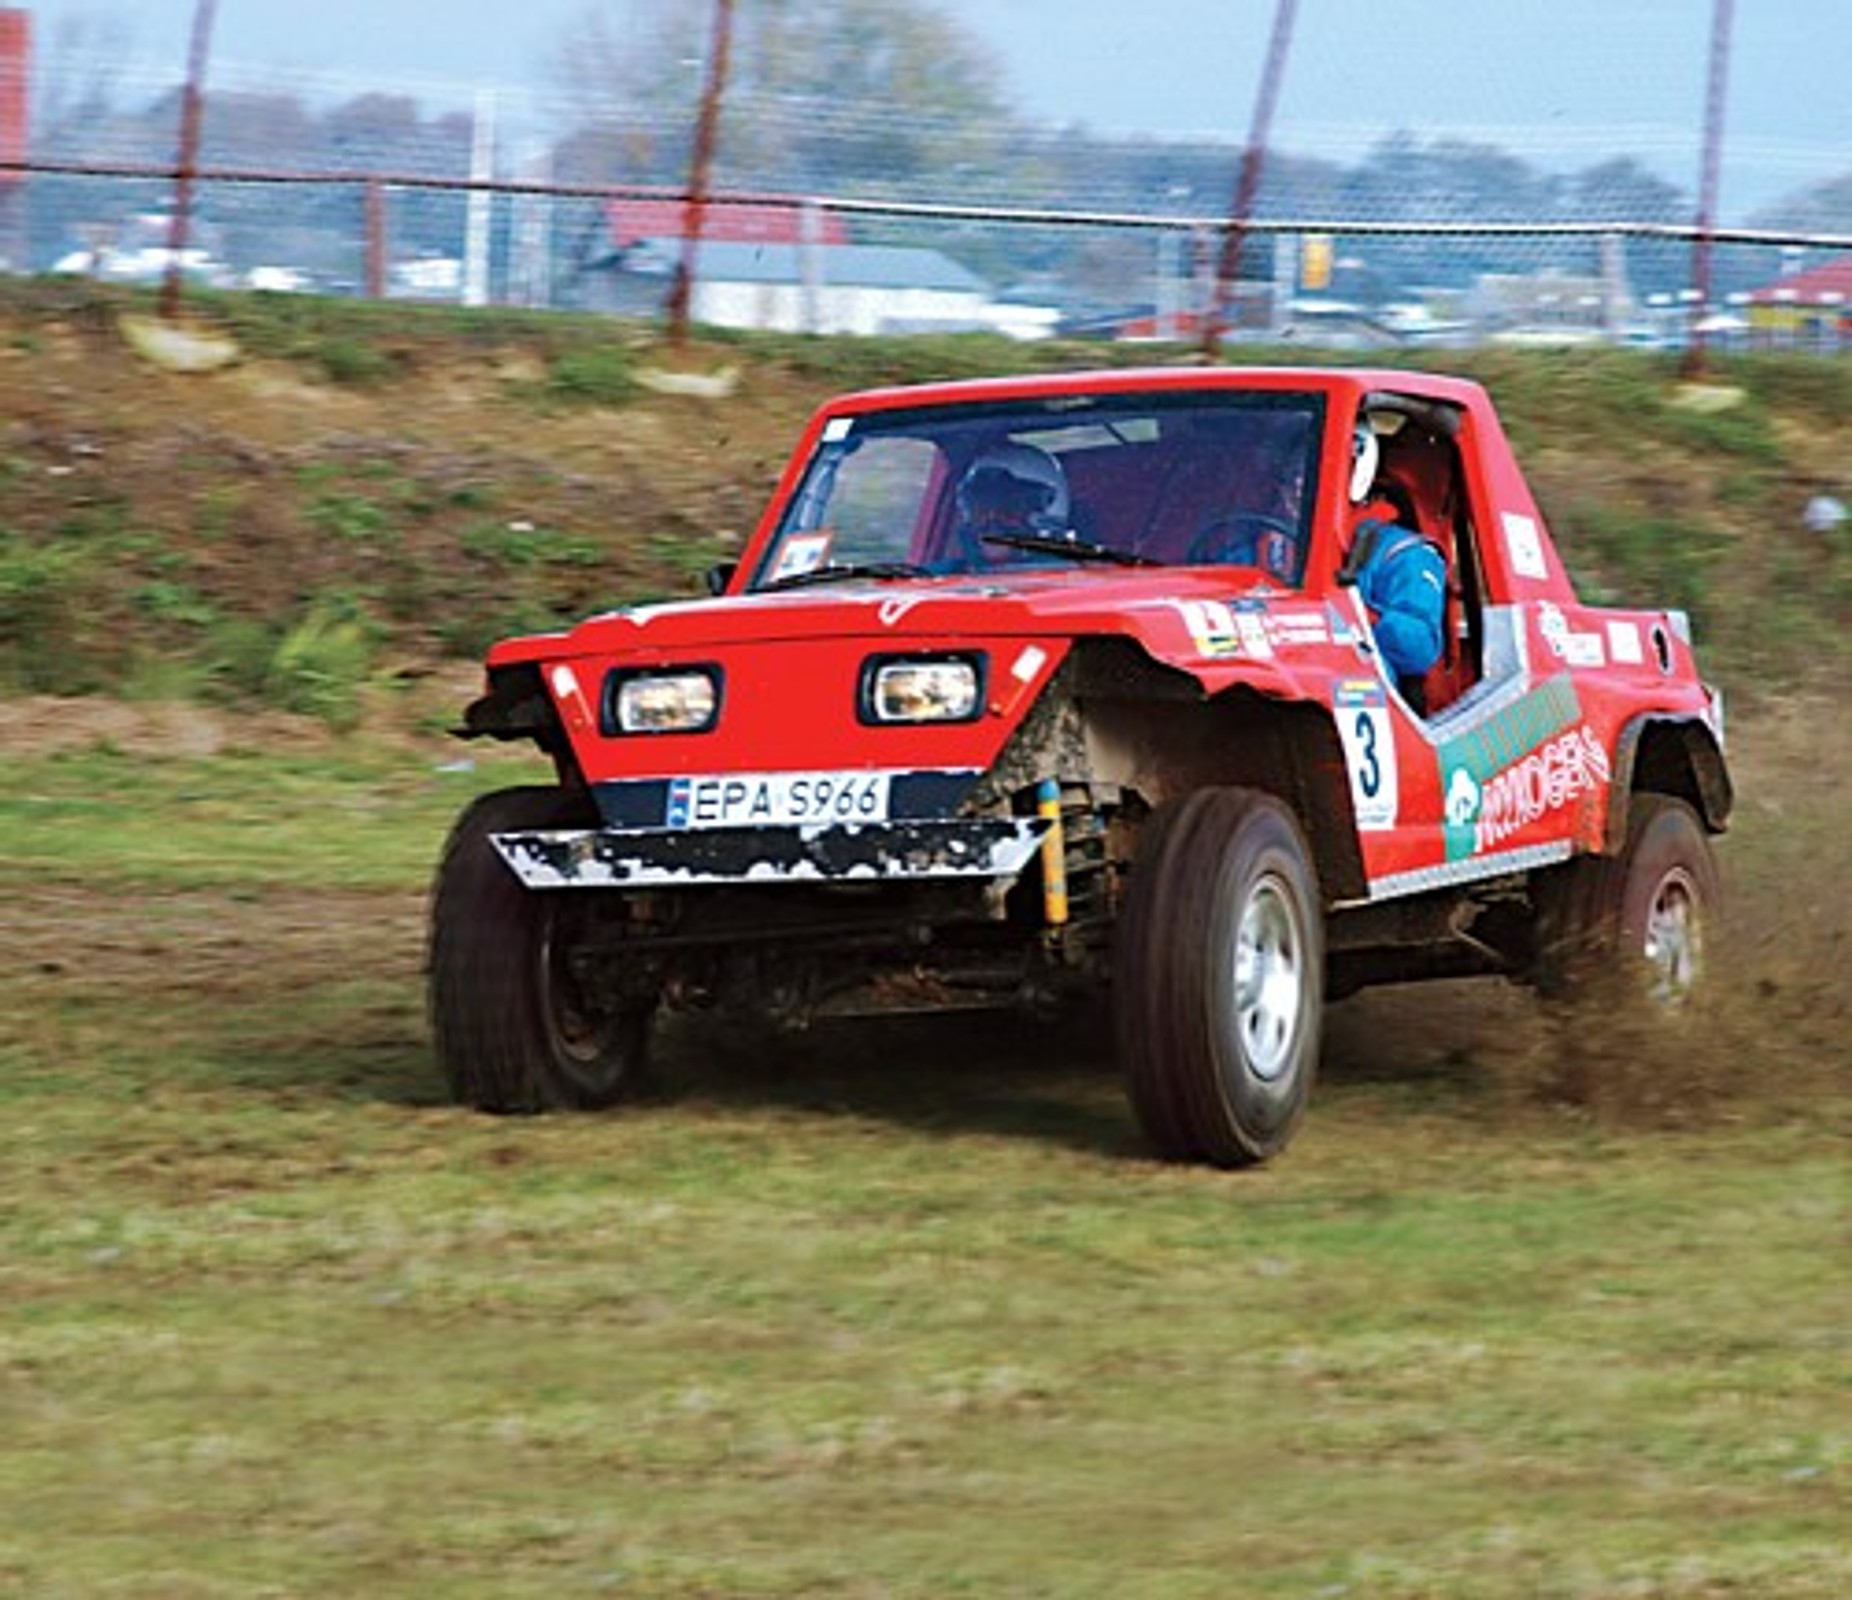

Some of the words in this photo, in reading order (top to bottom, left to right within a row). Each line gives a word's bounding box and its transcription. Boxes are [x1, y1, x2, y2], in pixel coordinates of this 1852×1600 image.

[1356, 711, 1379, 798] 3
[695, 780, 772, 820] EPA
[788, 778, 880, 817] S966
